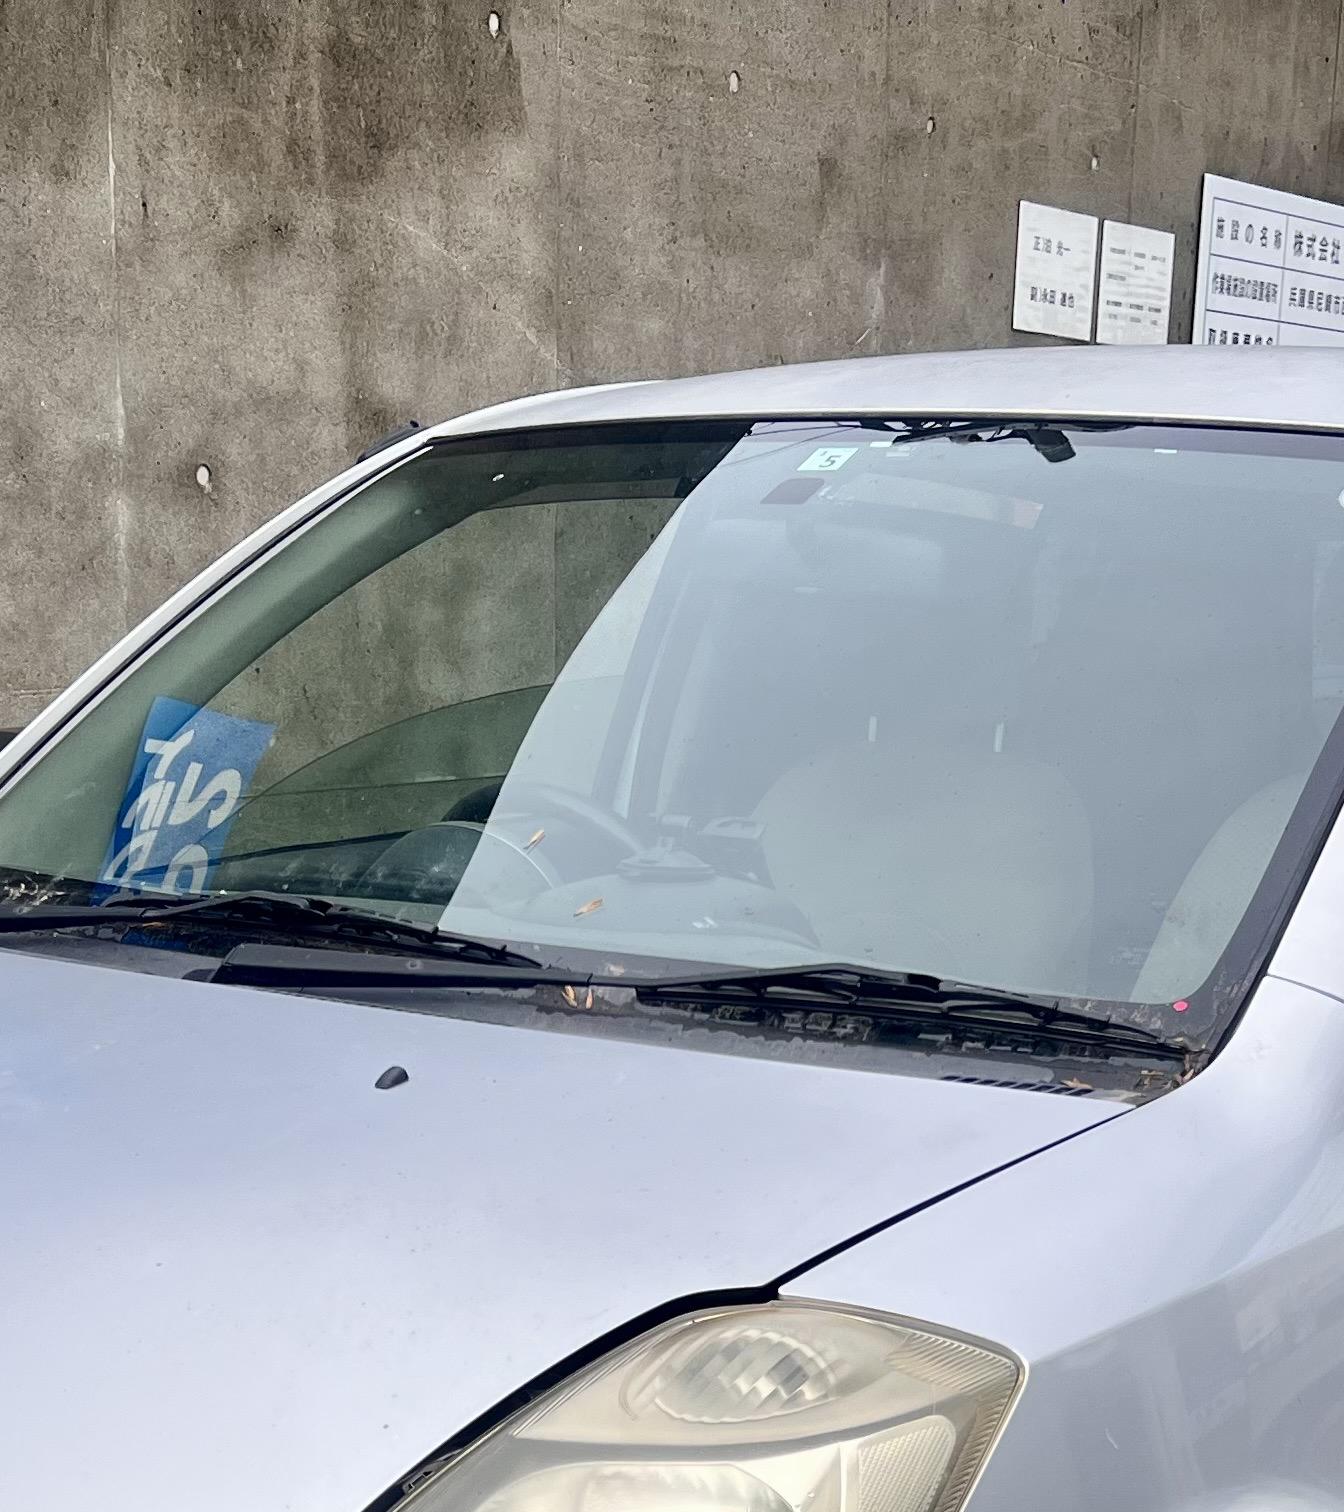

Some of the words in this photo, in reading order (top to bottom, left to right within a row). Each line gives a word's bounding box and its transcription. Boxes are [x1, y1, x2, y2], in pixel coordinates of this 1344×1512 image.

[1293, 229, 1341, 265] 株式会社
[818, 455, 842, 468] 5
